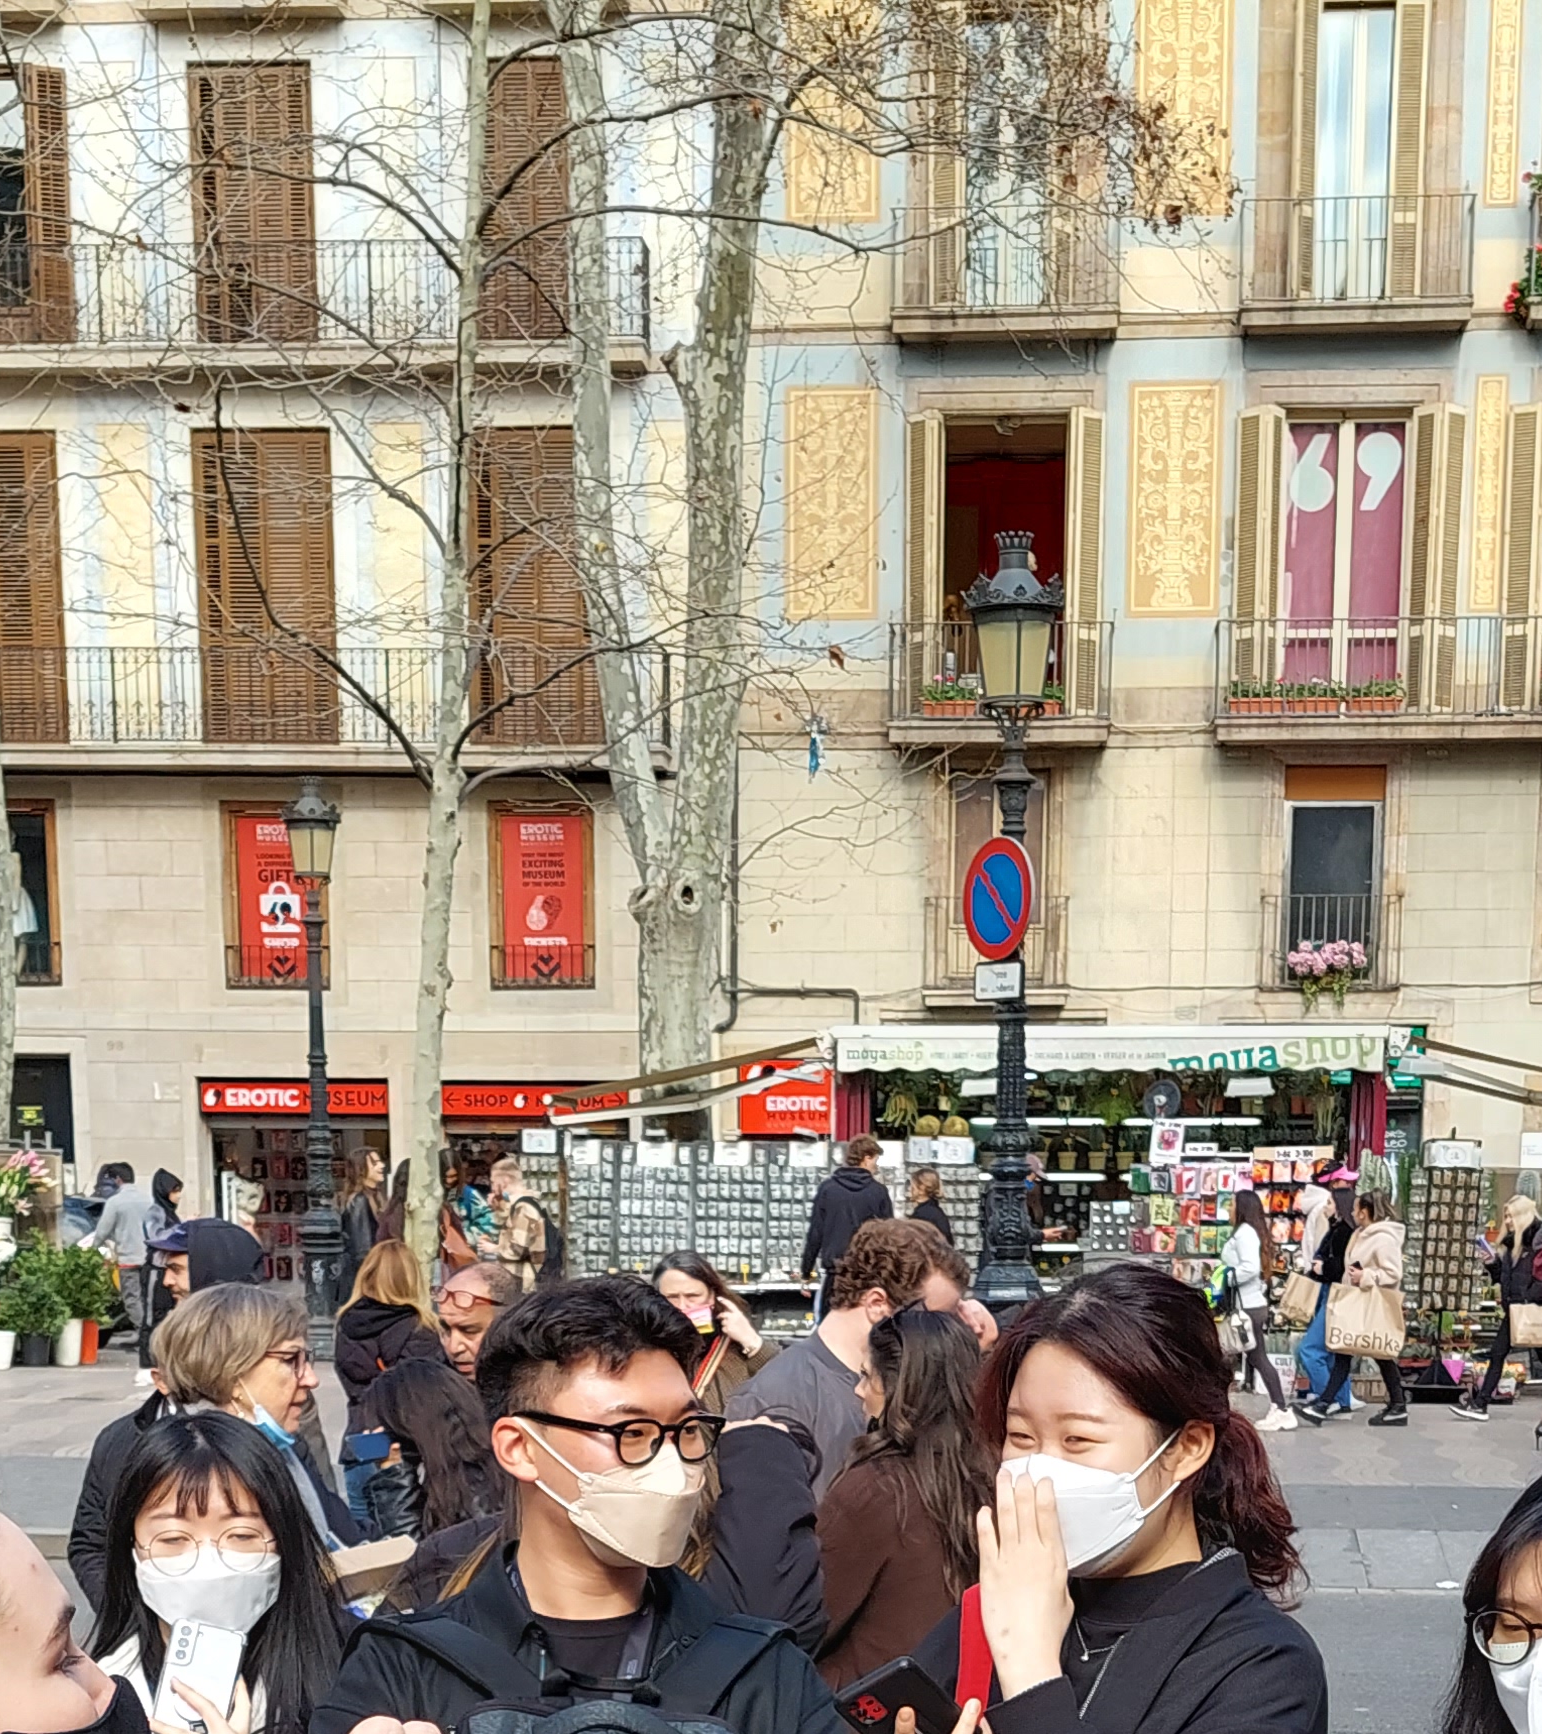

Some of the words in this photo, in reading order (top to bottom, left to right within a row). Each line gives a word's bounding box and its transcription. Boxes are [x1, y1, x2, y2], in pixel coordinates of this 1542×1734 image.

[519, 823, 564, 834] EROTIC
[522, 860, 565, 868] EXCITING
[522, 870, 565, 879] MUSEUM
[846, 1044, 924, 1064] moyashop
[225, 1088, 300, 1107] EROTIC
[463, 1093, 509, 1109] SHOP
[766, 1095, 828, 1112] EROTIC
[767, 1112, 829, 1121] MUSEUM
[1329, 1327, 1401, 1351] Bershka
